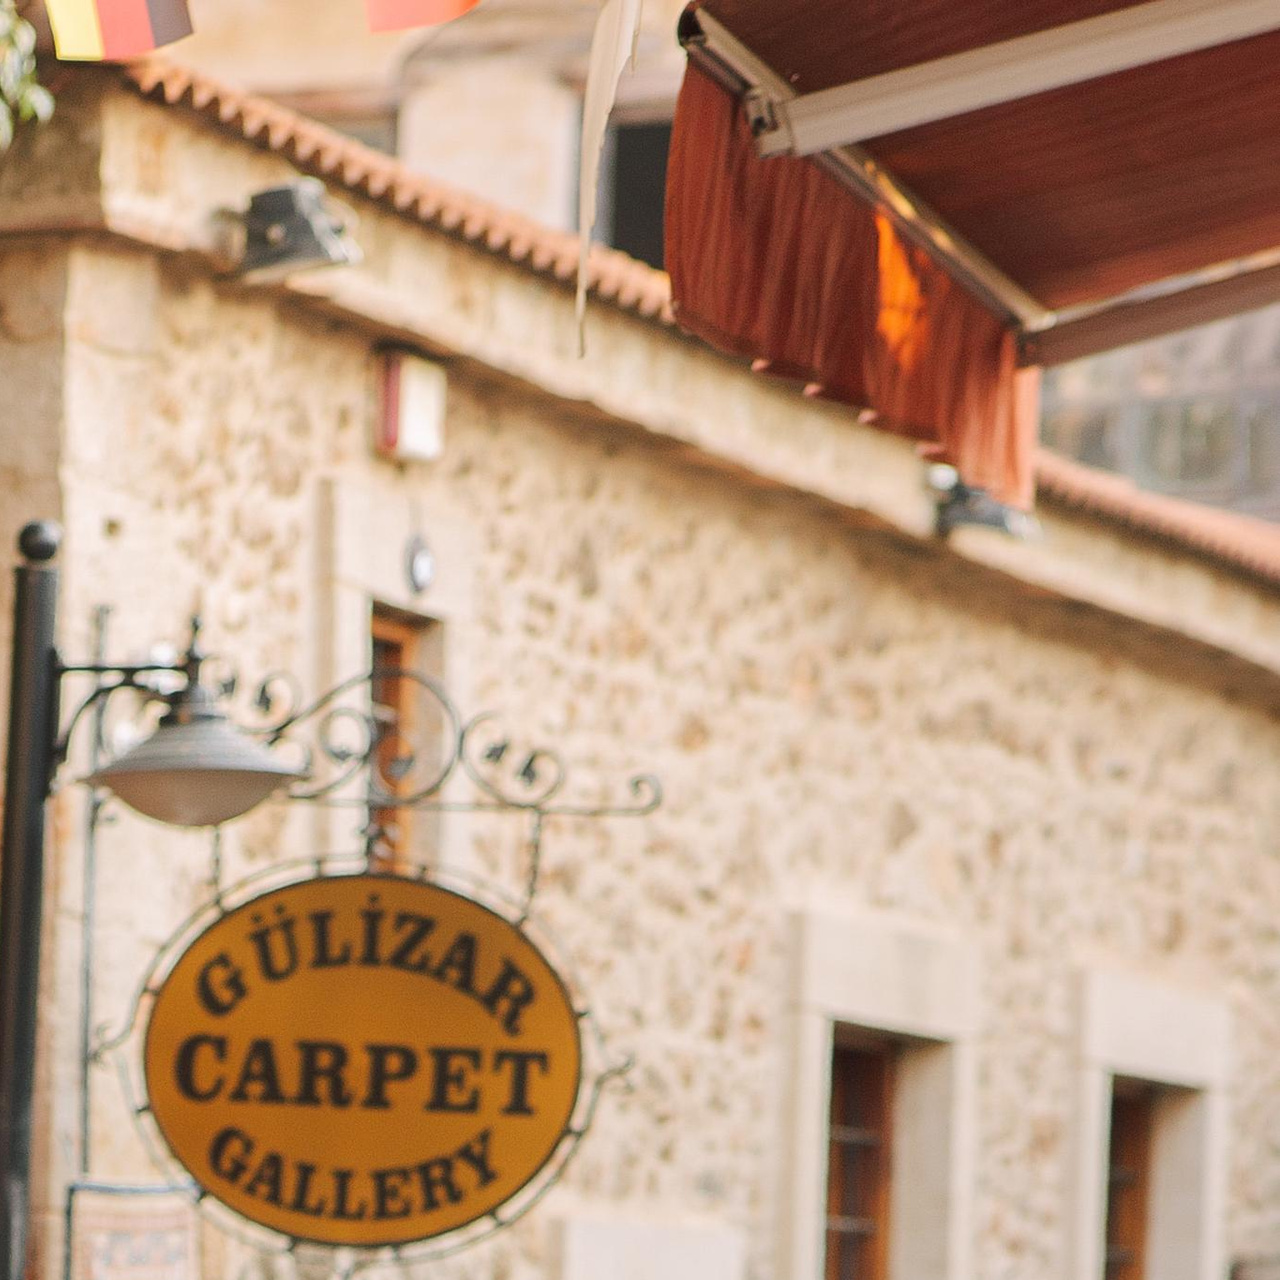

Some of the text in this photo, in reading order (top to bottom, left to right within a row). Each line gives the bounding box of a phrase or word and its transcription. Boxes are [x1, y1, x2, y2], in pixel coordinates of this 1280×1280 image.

[196, 893, 535, 1037] GÜLİZAR
[175, 1034, 549, 1117] CARPET
[208, 1126, 499, 1222] GALLERY
